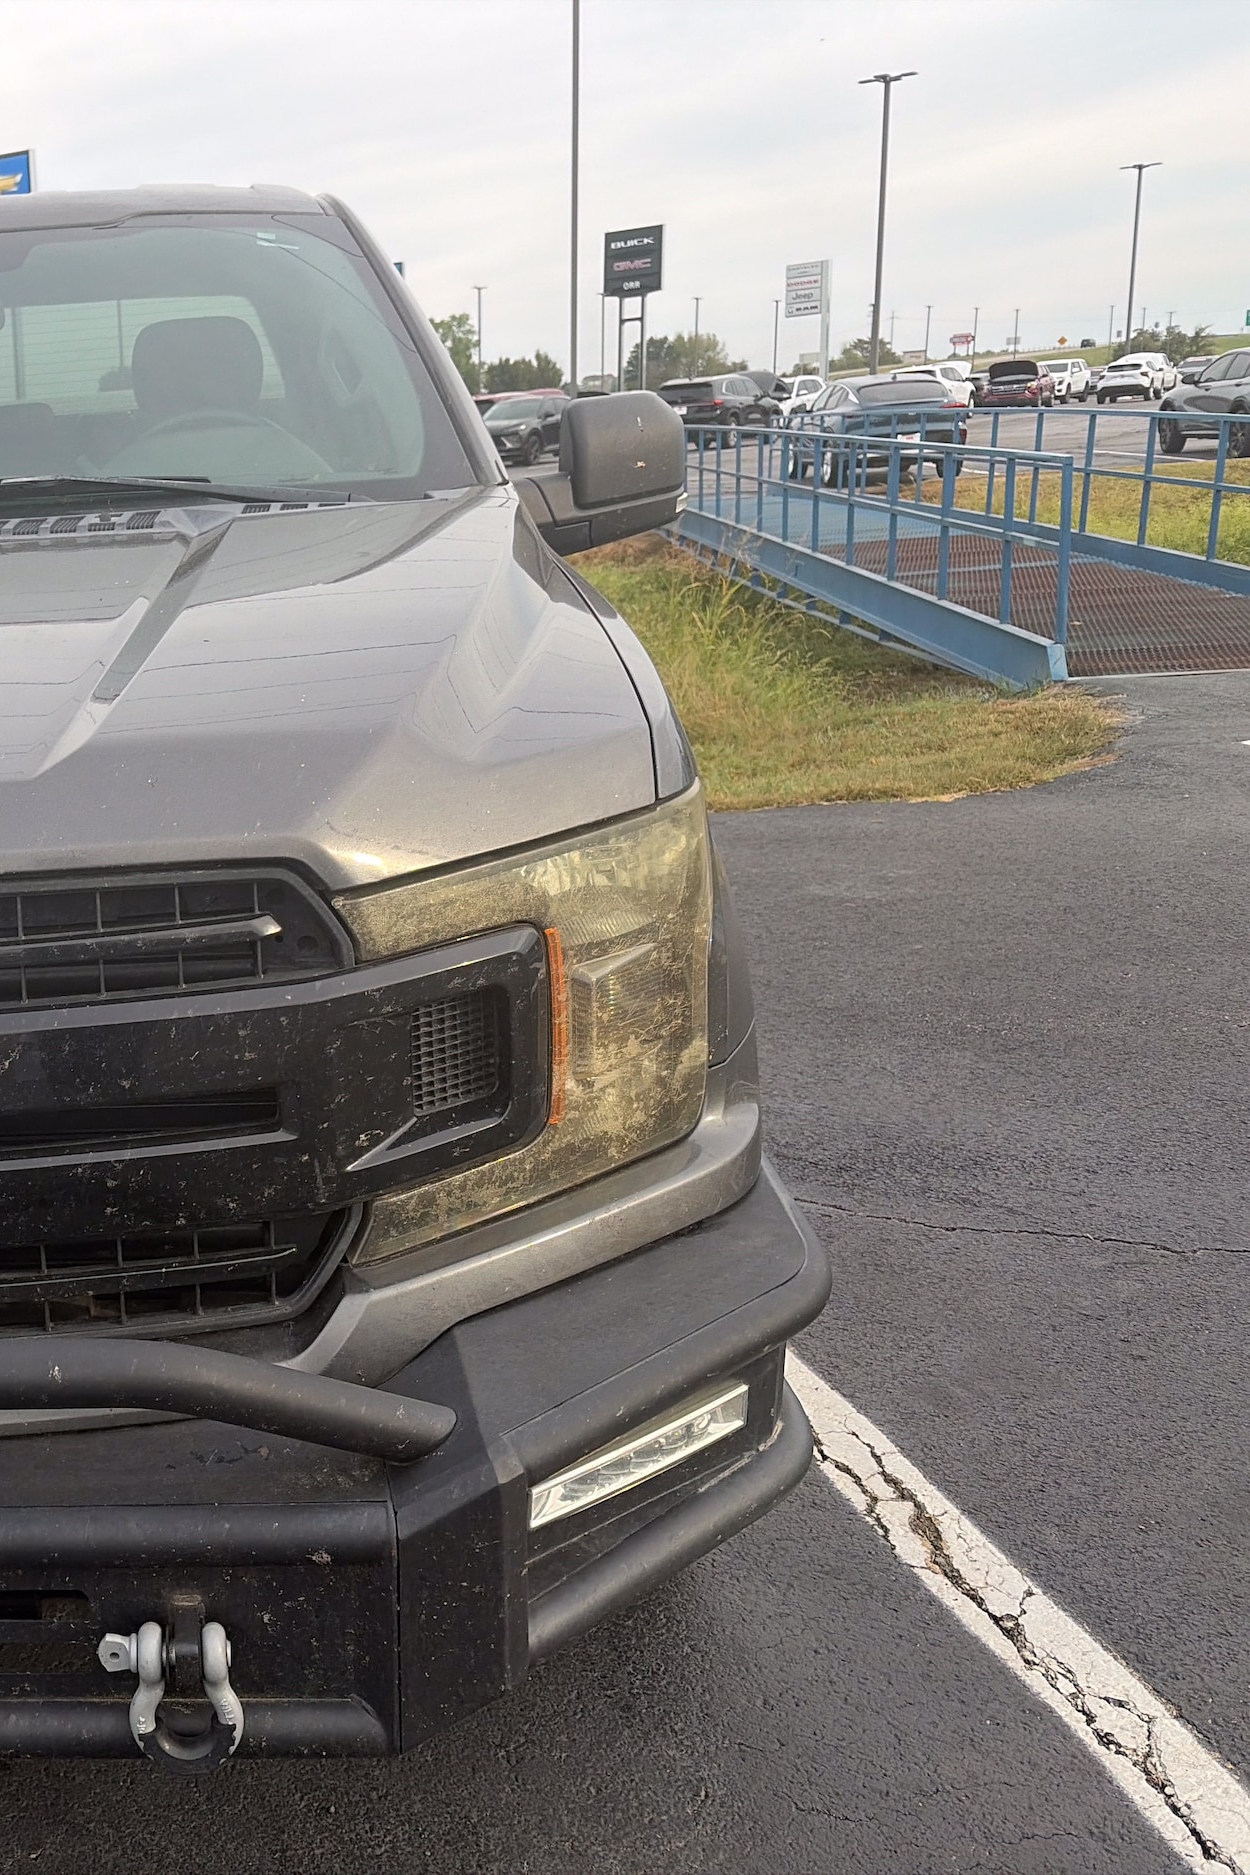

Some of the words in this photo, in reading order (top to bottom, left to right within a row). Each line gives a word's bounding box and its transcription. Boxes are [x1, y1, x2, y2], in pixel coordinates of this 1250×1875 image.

[610, 237, 655, 249] BUICK
[613, 258, 652, 271] GMC
[792, 292, 814, 301] Jeep
